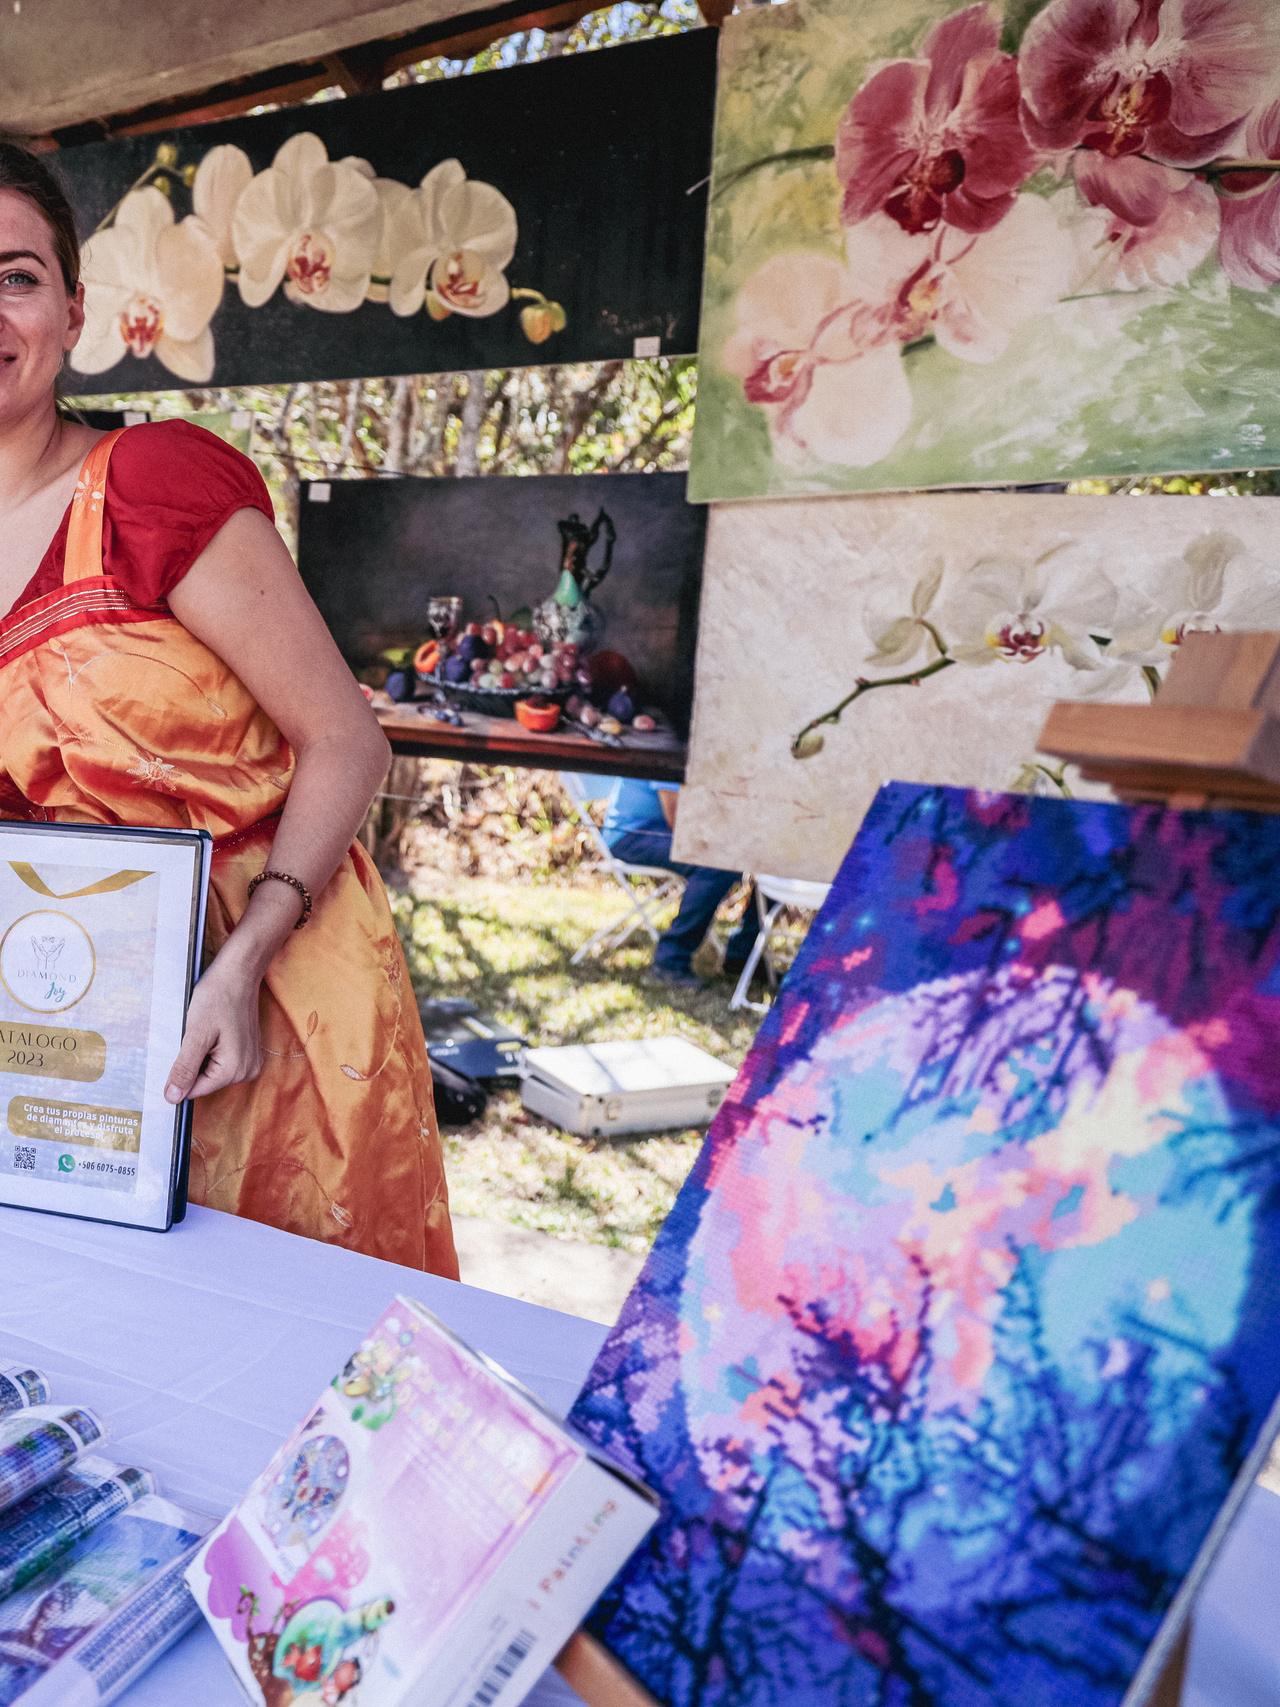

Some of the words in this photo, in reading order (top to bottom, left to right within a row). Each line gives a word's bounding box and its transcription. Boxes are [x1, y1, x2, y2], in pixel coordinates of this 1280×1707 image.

[17, 969, 76, 983] DIAMOND
[44, 981, 67, 1003] Joy
[7, 1050, 44, 1067] 2023
[23, 1103, 44, 1114] Crea
[46, 1106, 61, 1116] tus
[62, 1109, 97, 1120] propias
[99, 1114, 138, 1127] pinturas
[26, 1112, 38, 1122] de
[40, 1114, 87, 1129] diamantes
[89, 1122, 95, 1130] y
[97, 1122, 134, 1135] disfruta
[54, 1126, 63, 1134] el
[96, 1162, 136, 1176] 6075-0855
